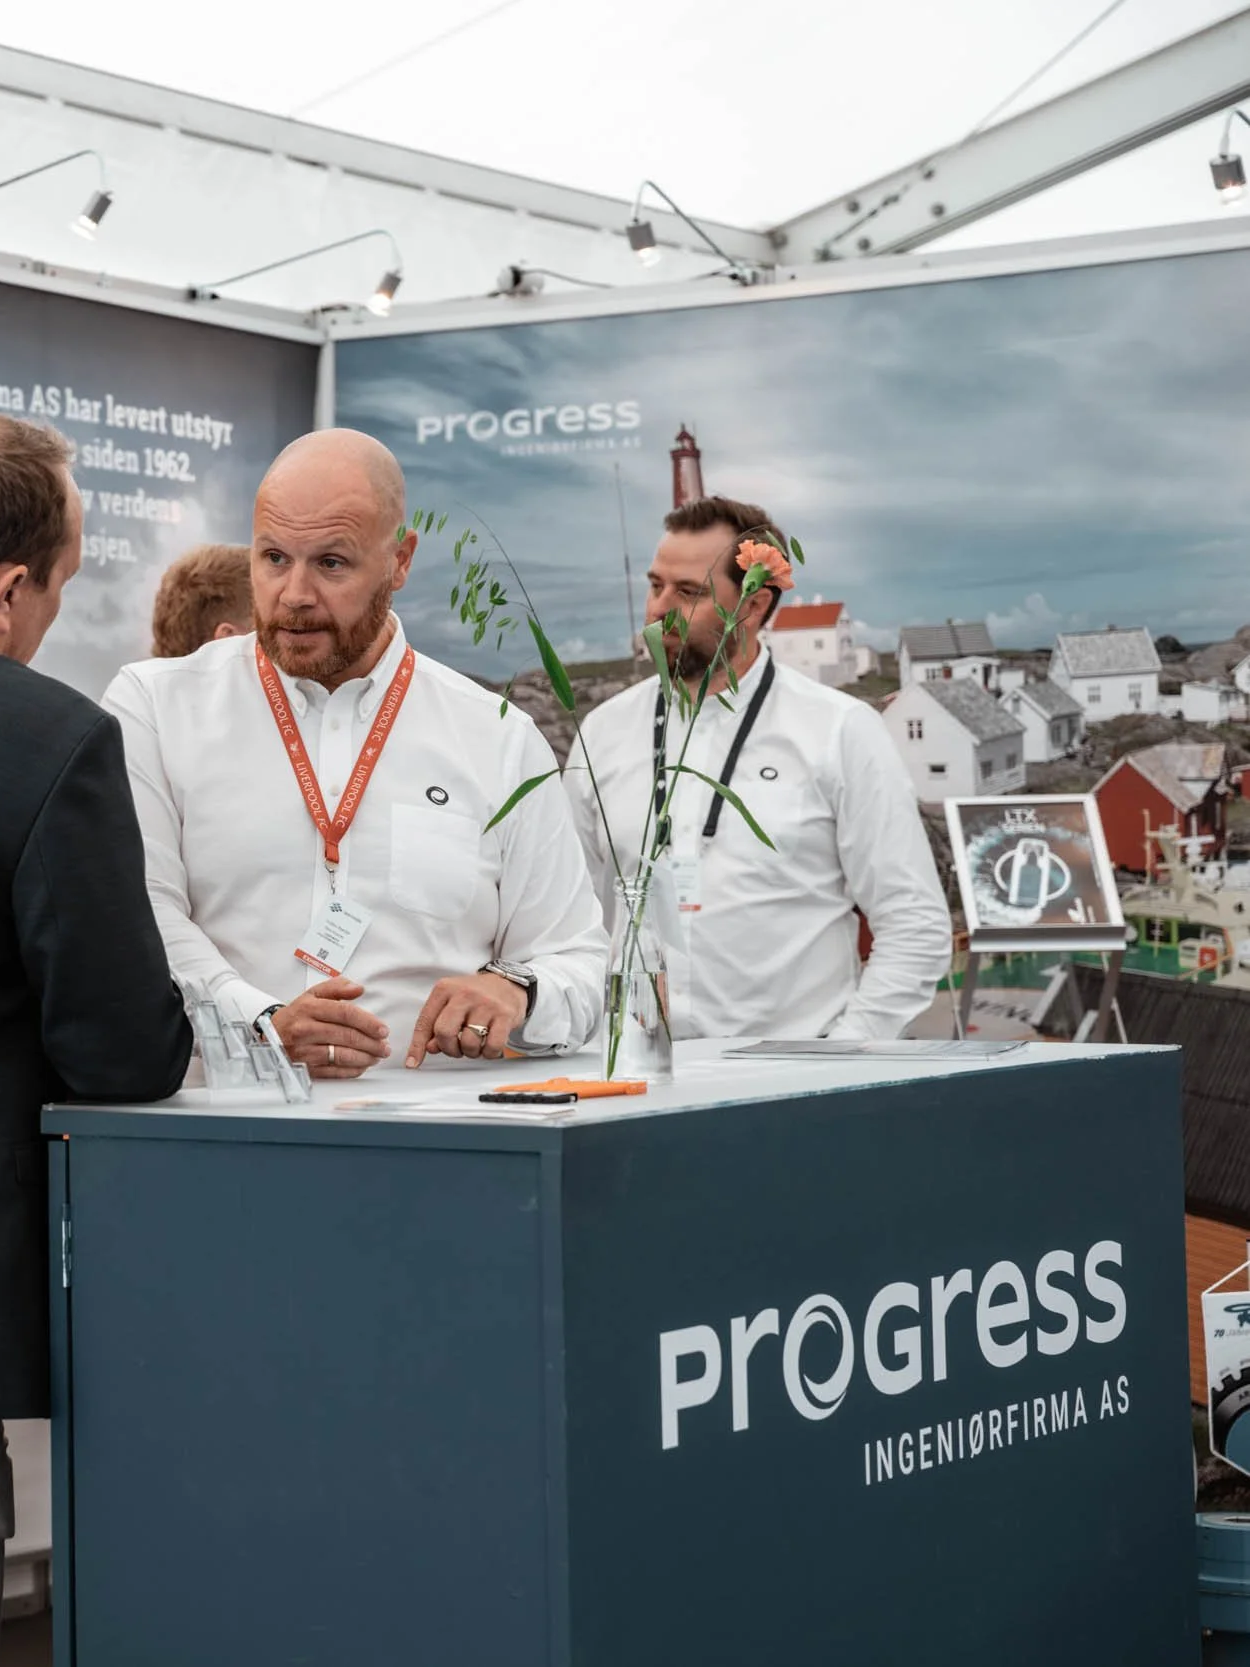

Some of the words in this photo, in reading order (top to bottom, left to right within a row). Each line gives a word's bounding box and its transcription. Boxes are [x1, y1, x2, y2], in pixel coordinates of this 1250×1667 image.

[29, 383, 62, 418] AS
[65, 387, 102, 425] har
[106, 394, 168, 434] levert
[172, 408, 235, 450] utstyr
[82, 437, 140, 473] siden
[144, 447, 197, 483] 1962.
[98, 487, 183, 524] verdens
[263, 673, 290, 724] LIVERPOOL
[375, 683, 405, 734] LIVERPOOL
[293, 760, 323, 816] LIVERPOOL
[342, 763, 371, 815] LIVERPOOL
[864, 1386, 1088, 1487] INGENIØRFIRMA
[1099, 1374, 1131, 1420] AS
